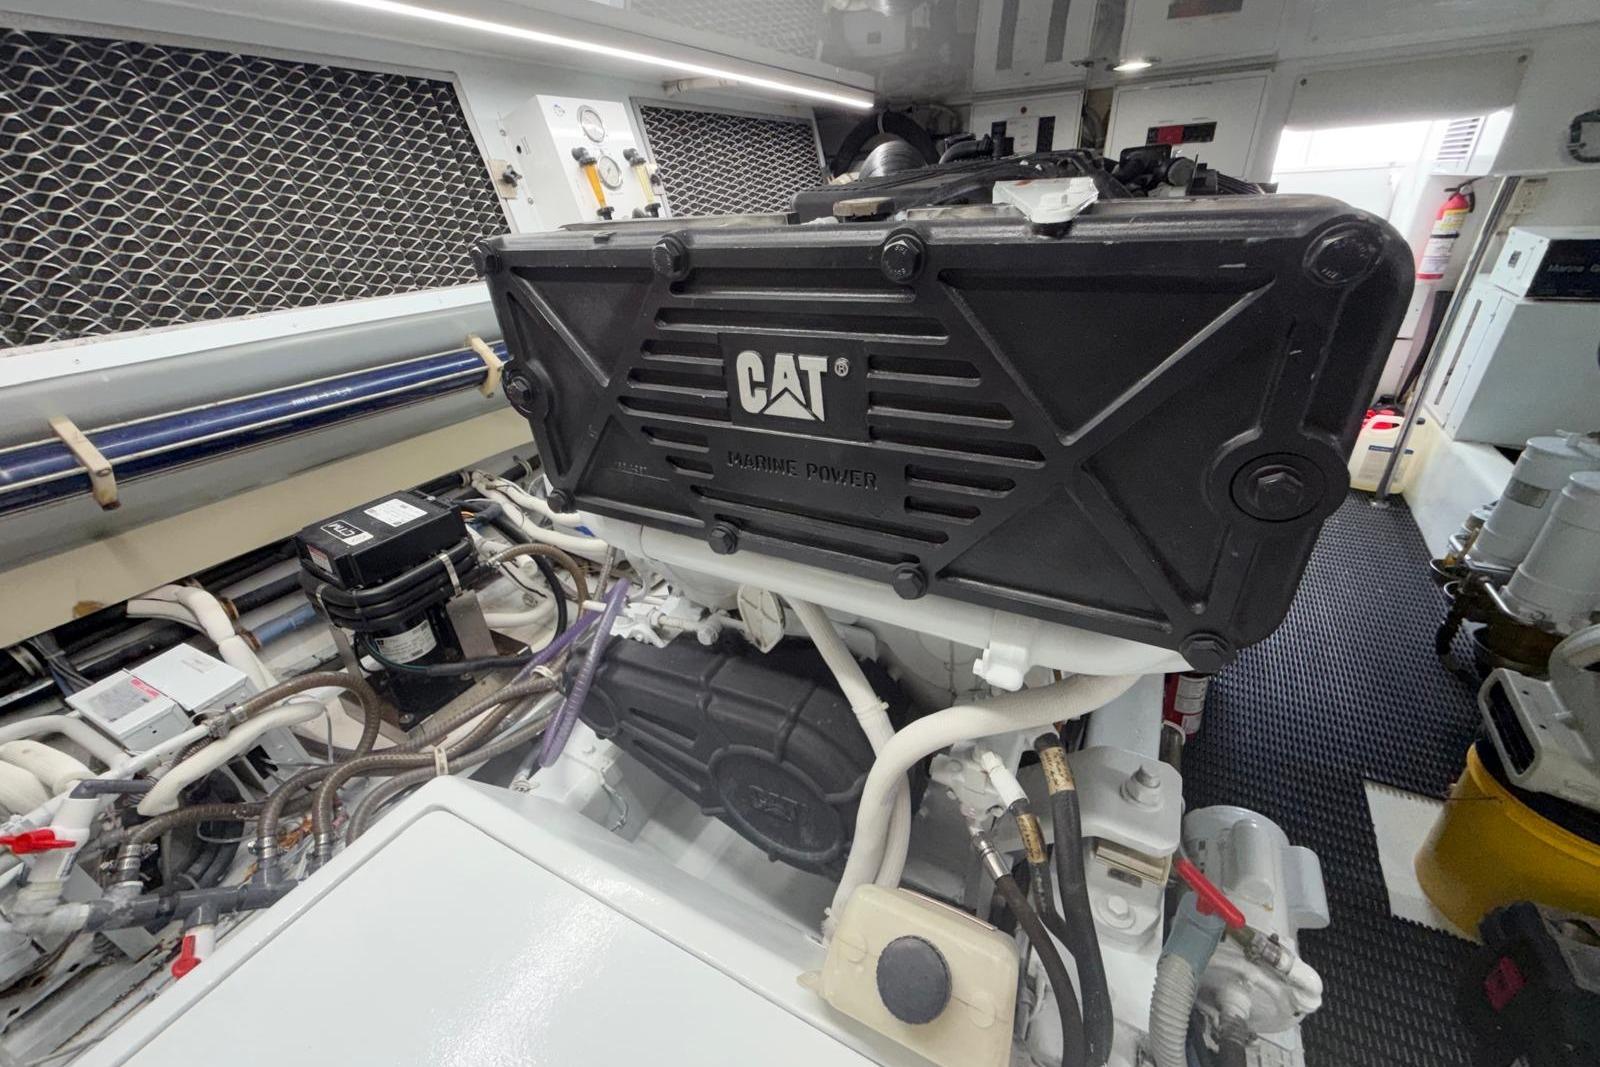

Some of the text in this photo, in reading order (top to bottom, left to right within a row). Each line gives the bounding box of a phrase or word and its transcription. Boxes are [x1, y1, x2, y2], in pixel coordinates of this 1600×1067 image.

[736, 350, 829, 422] CAT
[727, 450, 879, 491] MARINE POWER
